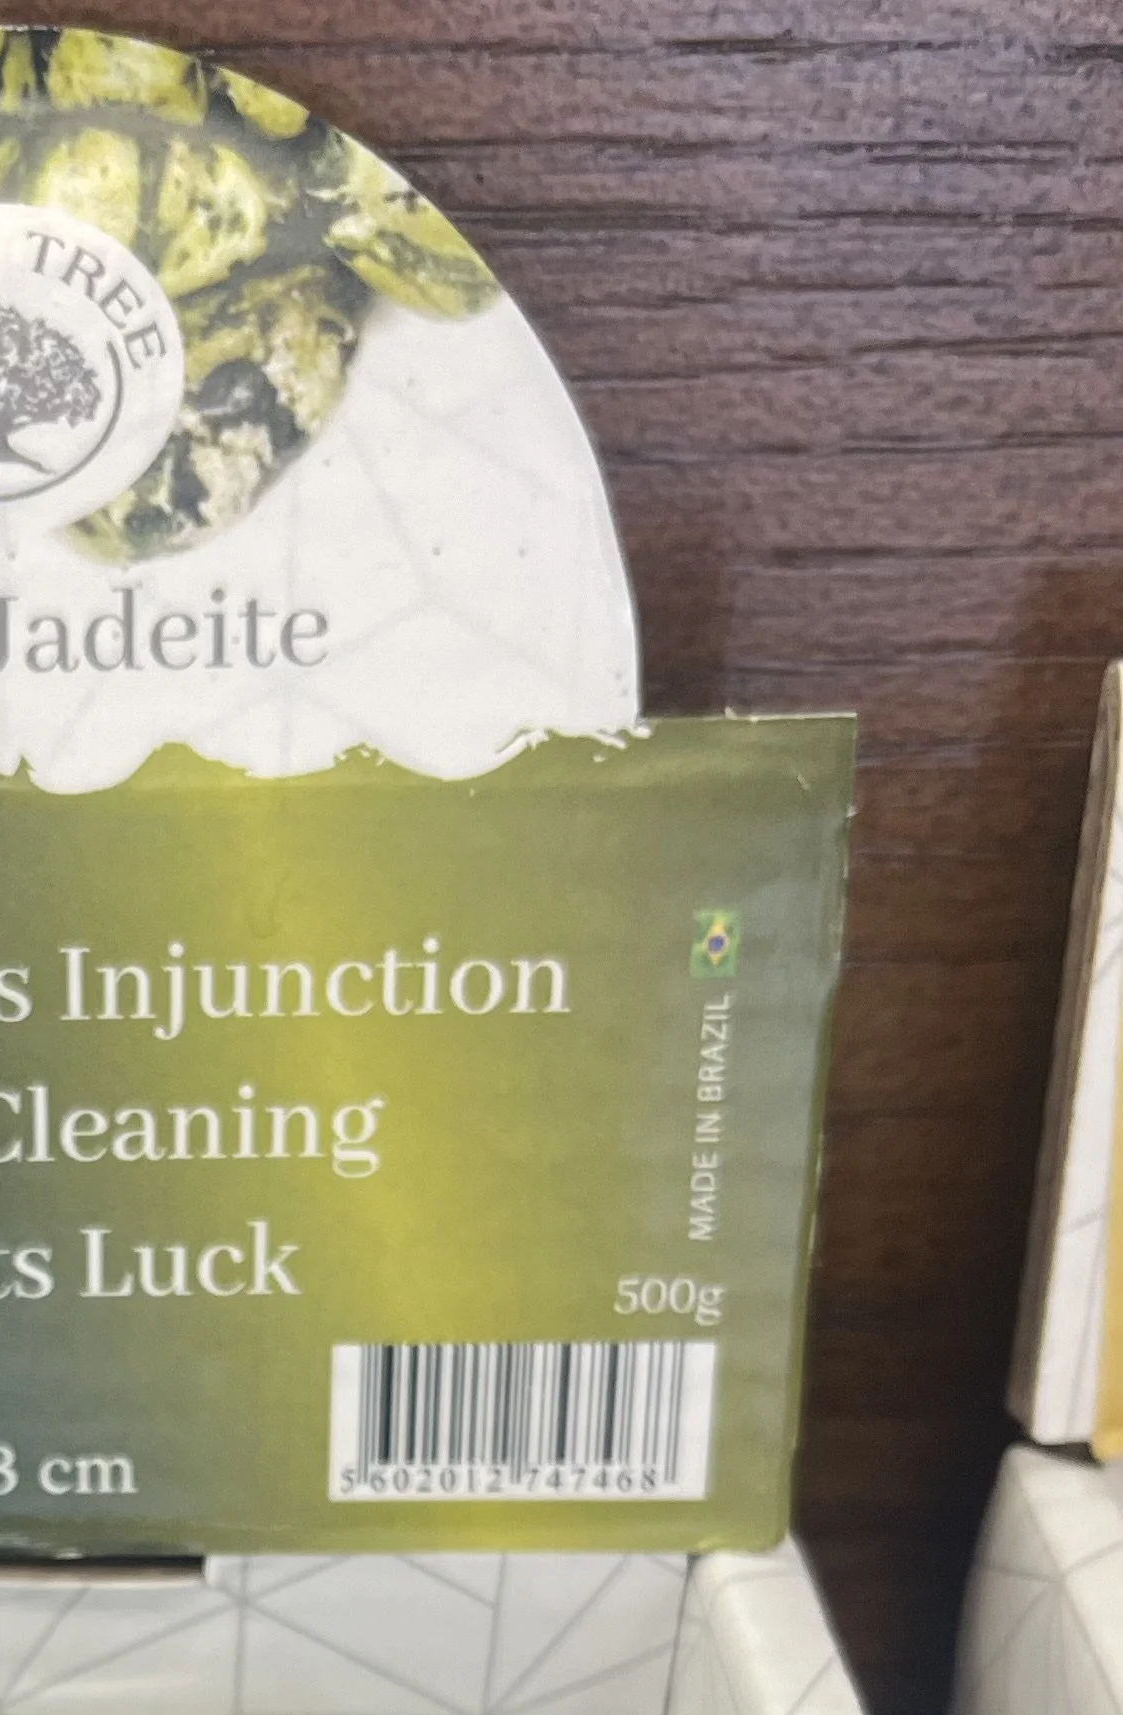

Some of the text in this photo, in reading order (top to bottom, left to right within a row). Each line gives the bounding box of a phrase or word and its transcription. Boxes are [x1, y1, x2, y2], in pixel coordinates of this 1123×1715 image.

[26, 230, 167, 371] TREE
[58, 936, 572, 1041] Injunction
[688, 993, 731, 1241] MADE IN BRAZIL
[79, 1220, 302, 1298] Luck
[614, 1276, 725, 1327] 500g
[38, 1456, 138, 1495] cm
